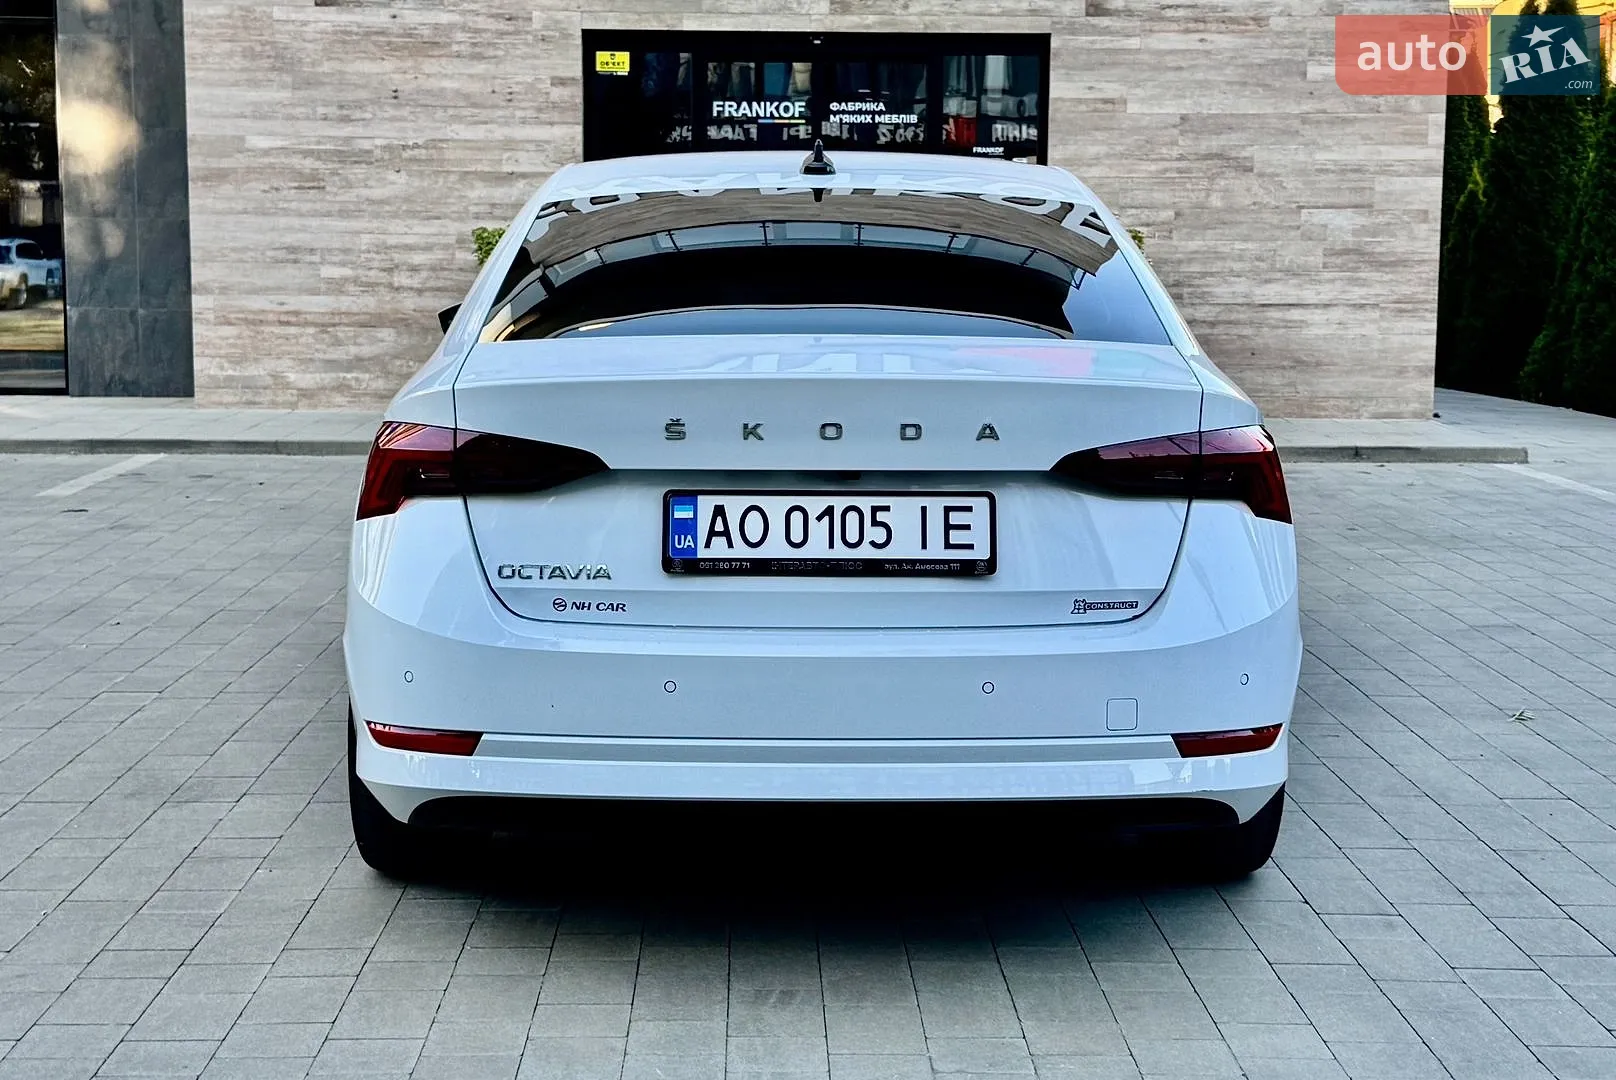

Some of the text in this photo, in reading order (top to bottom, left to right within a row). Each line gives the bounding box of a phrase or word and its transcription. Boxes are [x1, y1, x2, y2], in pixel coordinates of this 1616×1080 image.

[712, 101, 806, 117] FRANKOF
[829, 102, 886, 111] ФАБРИКА
[829, 114, 918, 124] М'ЯКИХ МЕБЛІВ
[704, 504, 975, 550] AO 0105 IE
[674, 534, 695, 548] UA
[498, 564, 612, 580] OCTAVIA
[570, 601, 627, 612] NH CAR
[1085, 602, 1138, 610] CONSTRUCT
